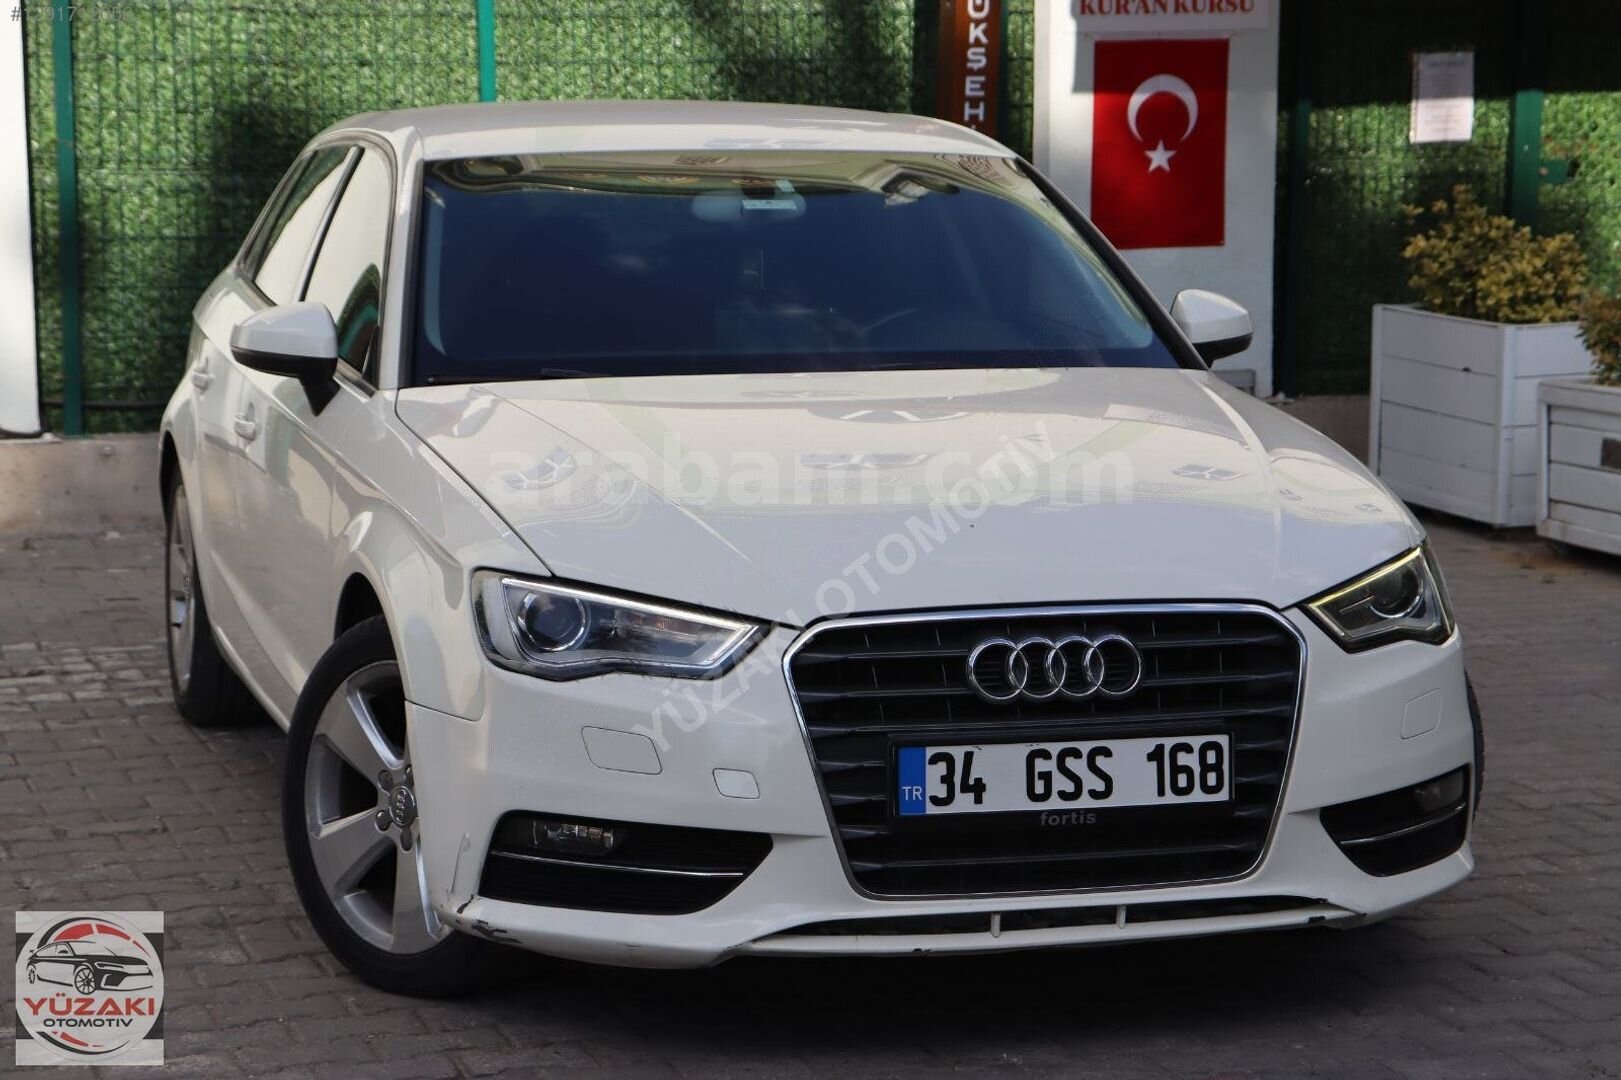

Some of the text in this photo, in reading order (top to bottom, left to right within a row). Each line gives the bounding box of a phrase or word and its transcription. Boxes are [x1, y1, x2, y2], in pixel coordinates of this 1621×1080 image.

[1079, 0, 1255, 15] KUR'AN KURSU
[902, 740, 1224, 807] TR 34 GSS 168
[1040, 808, 1096, 827] fortis
